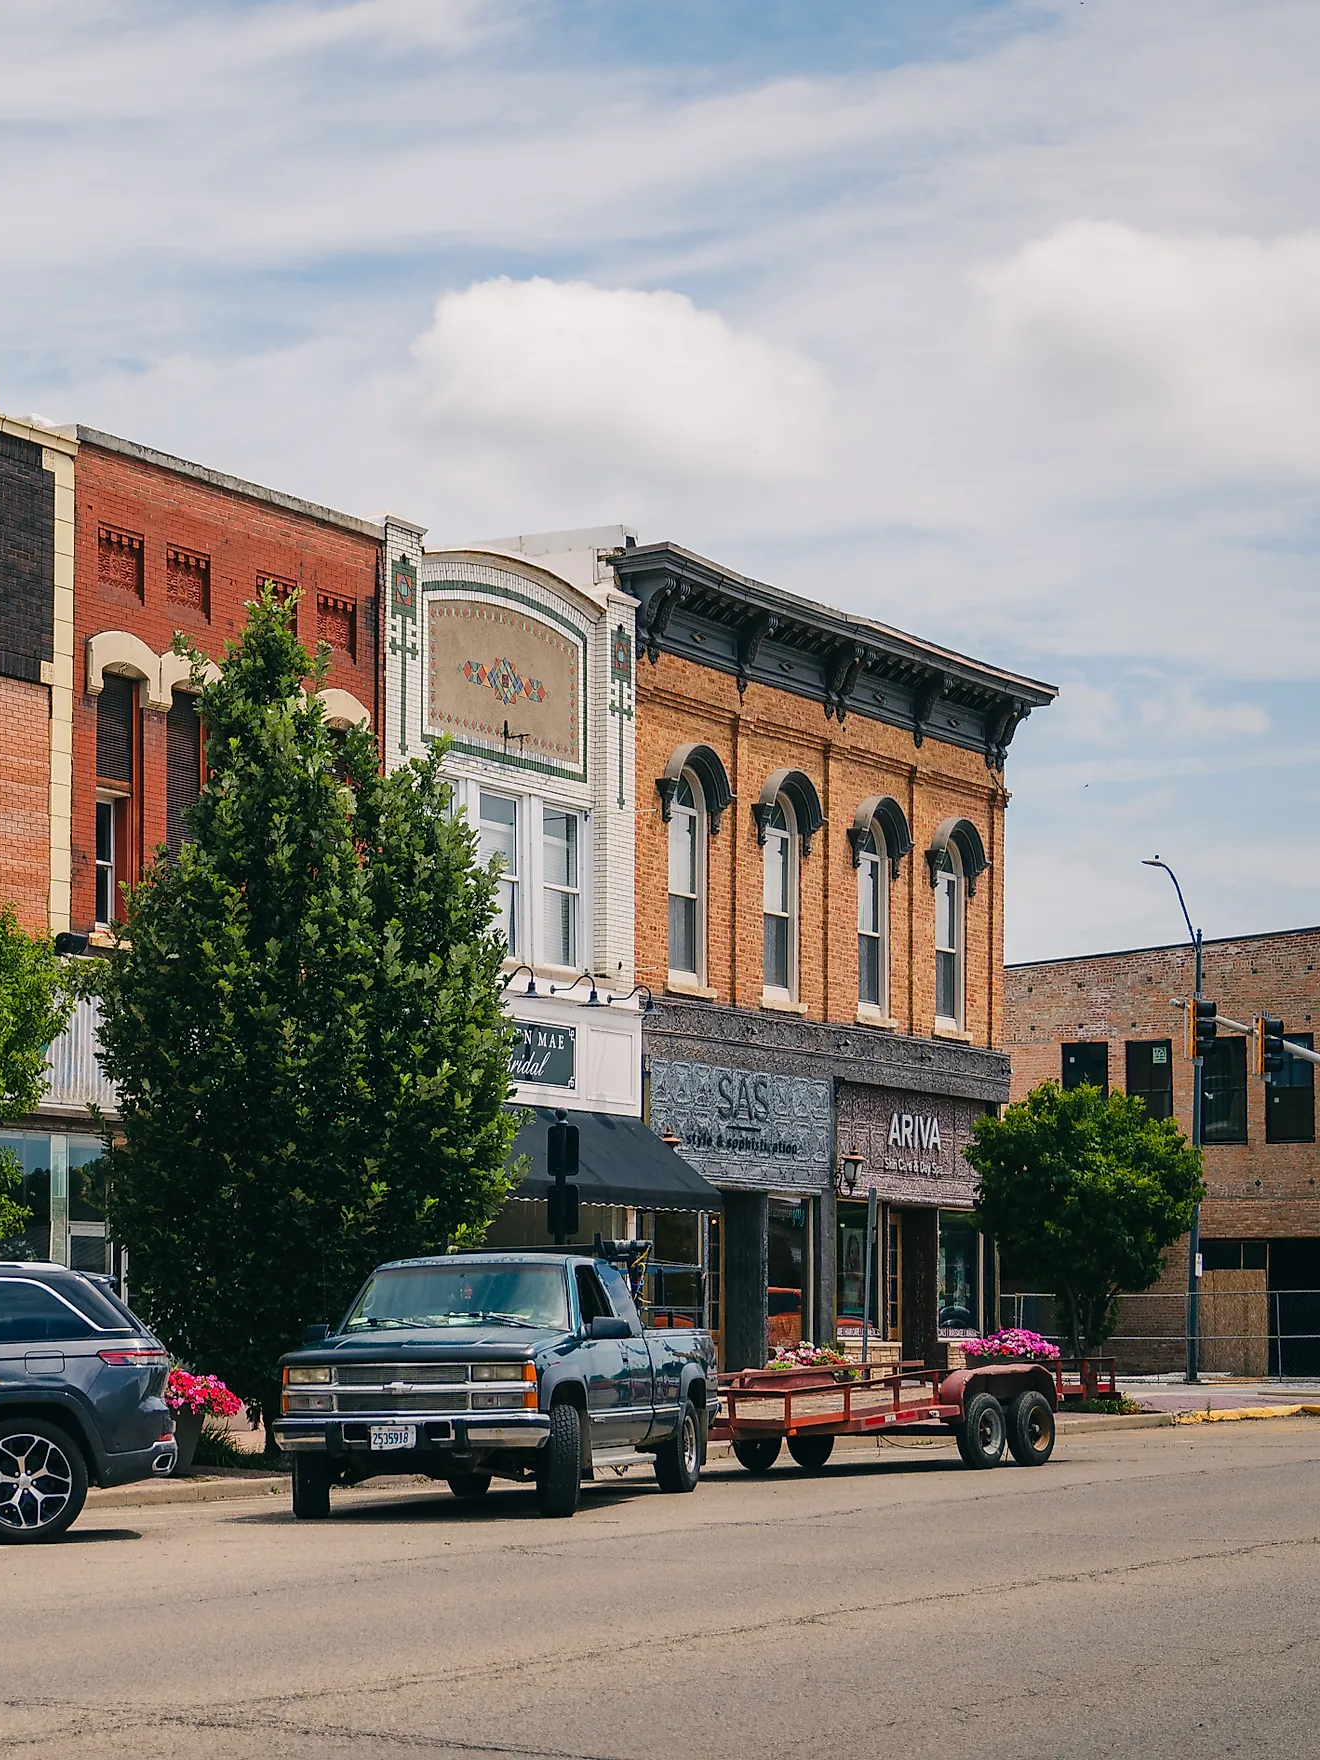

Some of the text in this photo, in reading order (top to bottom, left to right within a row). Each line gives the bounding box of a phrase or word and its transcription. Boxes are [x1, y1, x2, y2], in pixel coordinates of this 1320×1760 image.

[537, 1031, 565, 1050] MAE
[718, 1074, 770, 1122] SAS
[685, 1131, 712, 1148] style
[887, 1112, 941, 1151] ARIVA
[884, 1157, 944, 1177] Skin Care & Day Spa
[373, 1431, 409, 1446] 2535918
